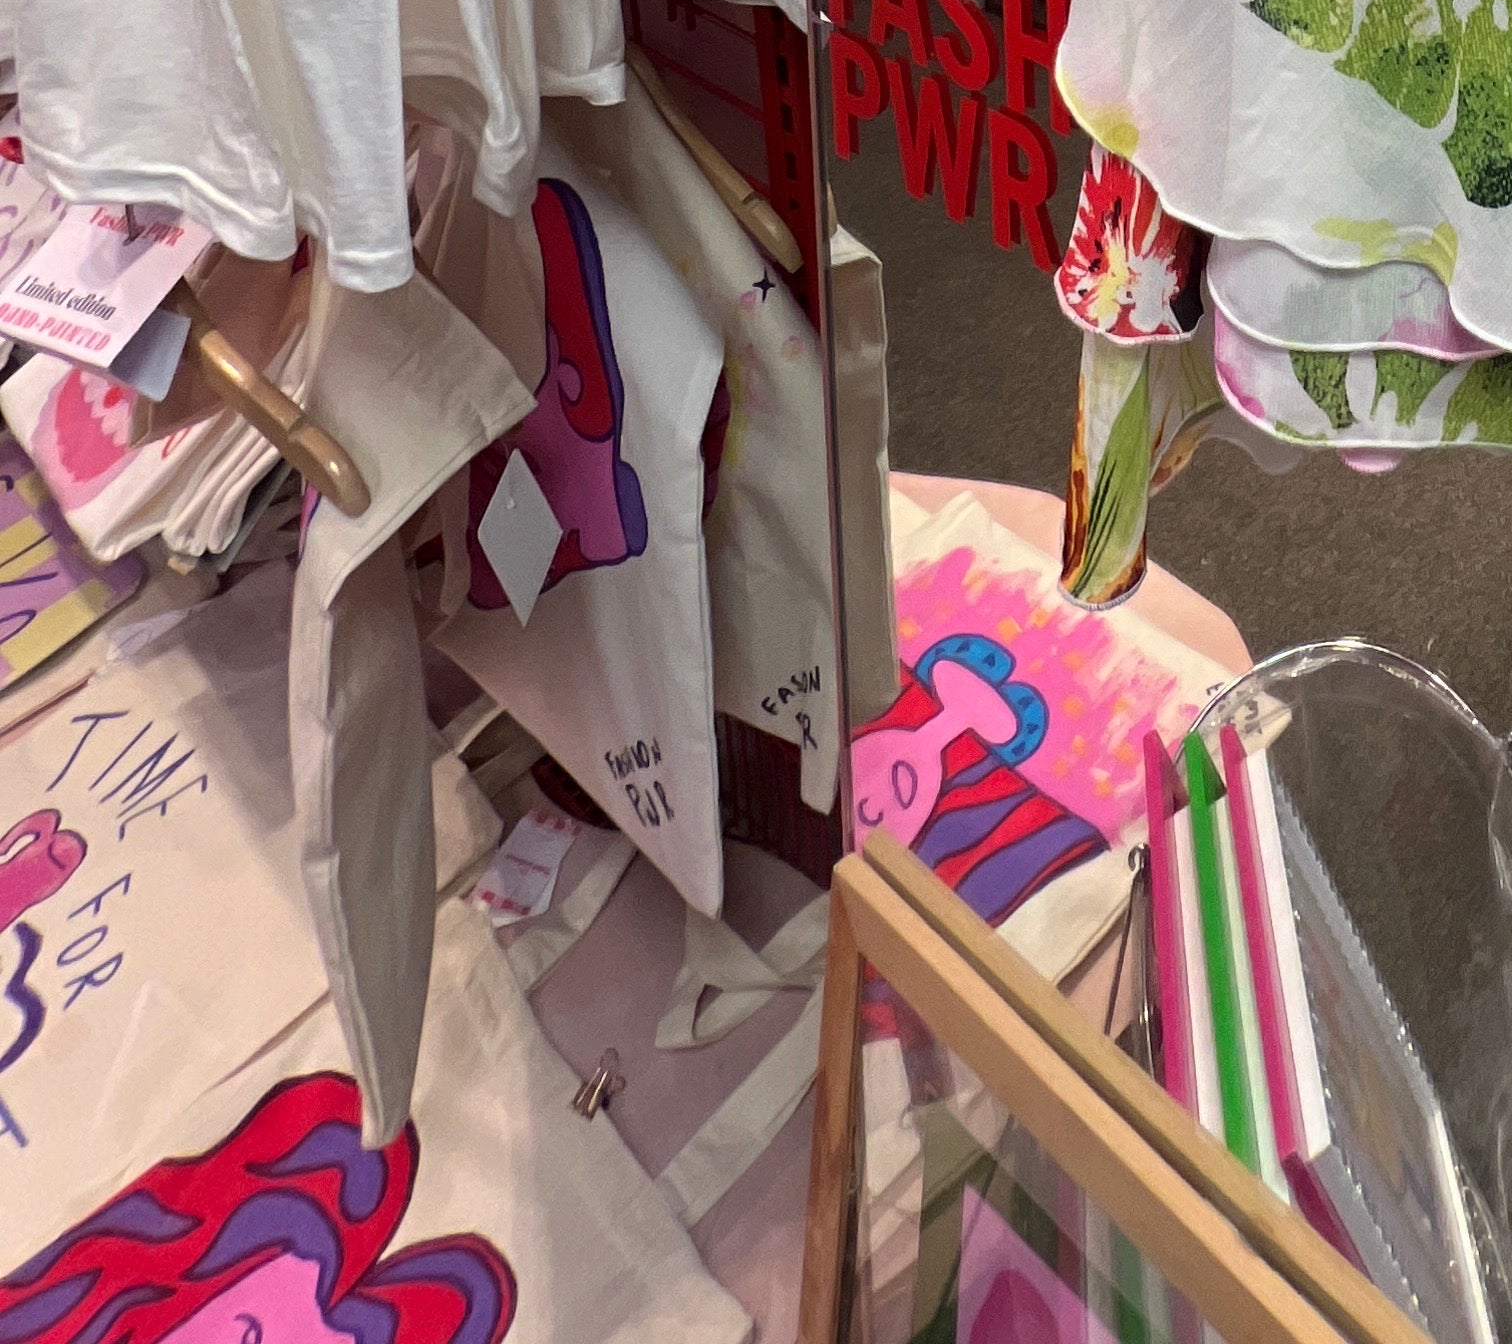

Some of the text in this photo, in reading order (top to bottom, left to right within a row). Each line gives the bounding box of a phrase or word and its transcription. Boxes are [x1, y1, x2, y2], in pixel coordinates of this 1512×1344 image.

[829, 31, 1063, 272] PWR
[15, 275, 117, 321] Limited edition
[47, 710, 208, 841] TIME
[56, 872, 134, 1010] FOR
